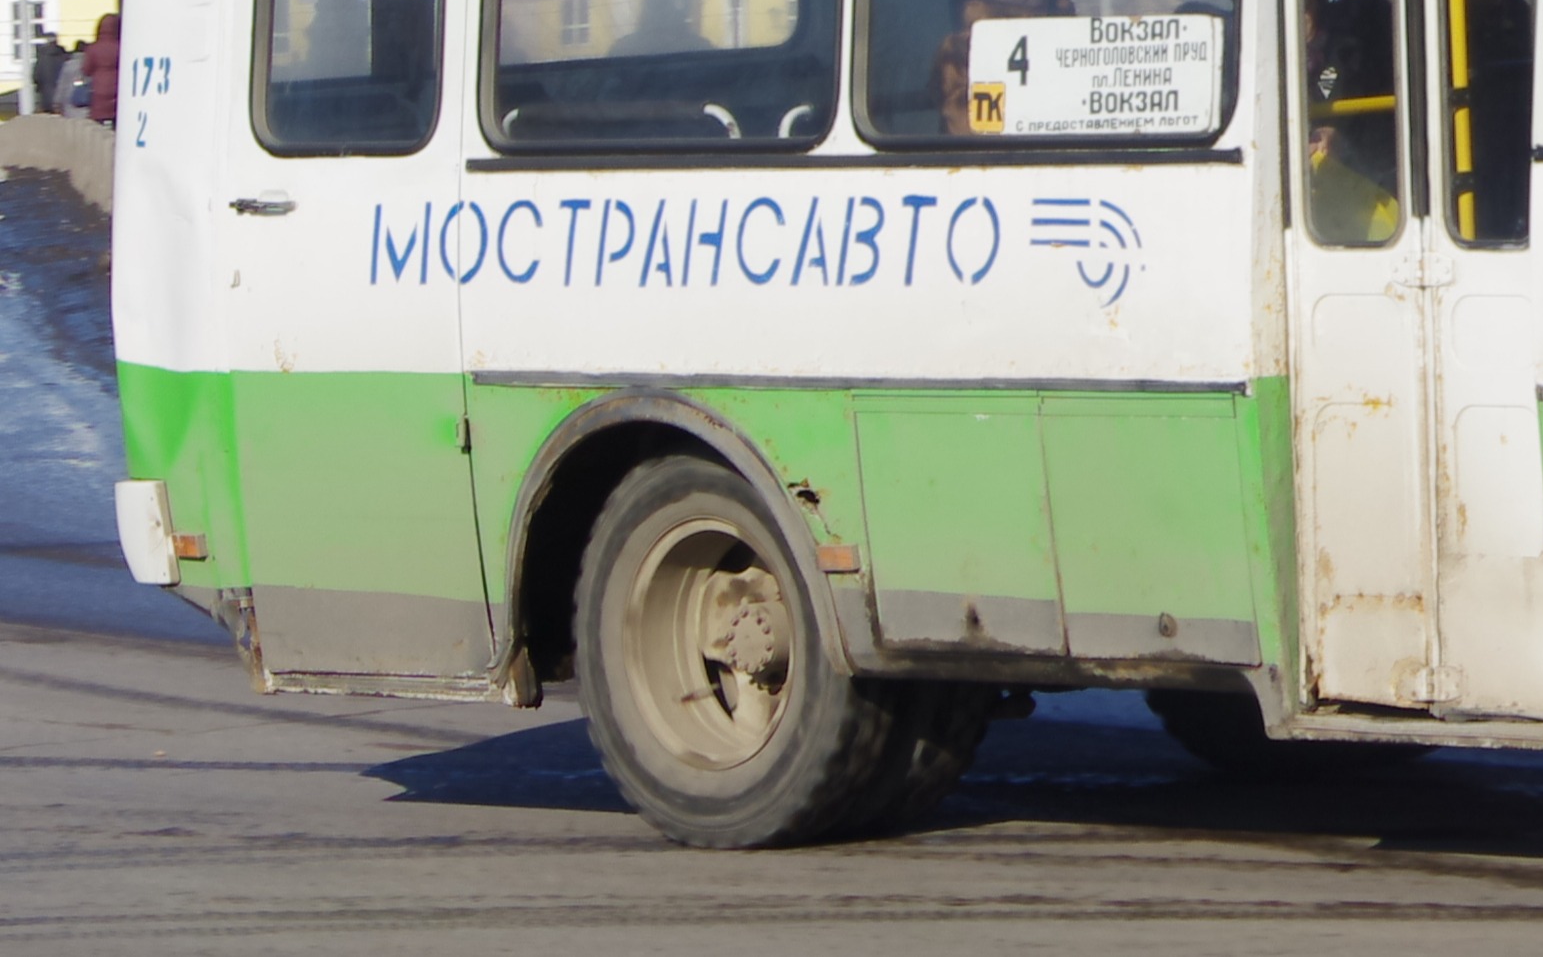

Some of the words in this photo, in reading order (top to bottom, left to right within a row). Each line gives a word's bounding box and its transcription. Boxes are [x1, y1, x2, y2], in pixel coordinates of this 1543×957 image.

[1007, 35, 1030, 86] 4
[1173, 41, 1208, 63] ПРУД
[131, 56, 171, 98] 173
[973, 91, 1004, 123] ТК
[1015, 121, 1024, 132] С
[1028, 116, 1155, 132] ПРЕДОСТАВЛЕНИЕМ
[1159, 114, 1199, 128] ЛЬГОТ
[369, 196, 1001, 287] МОСТРАНСАВТО
